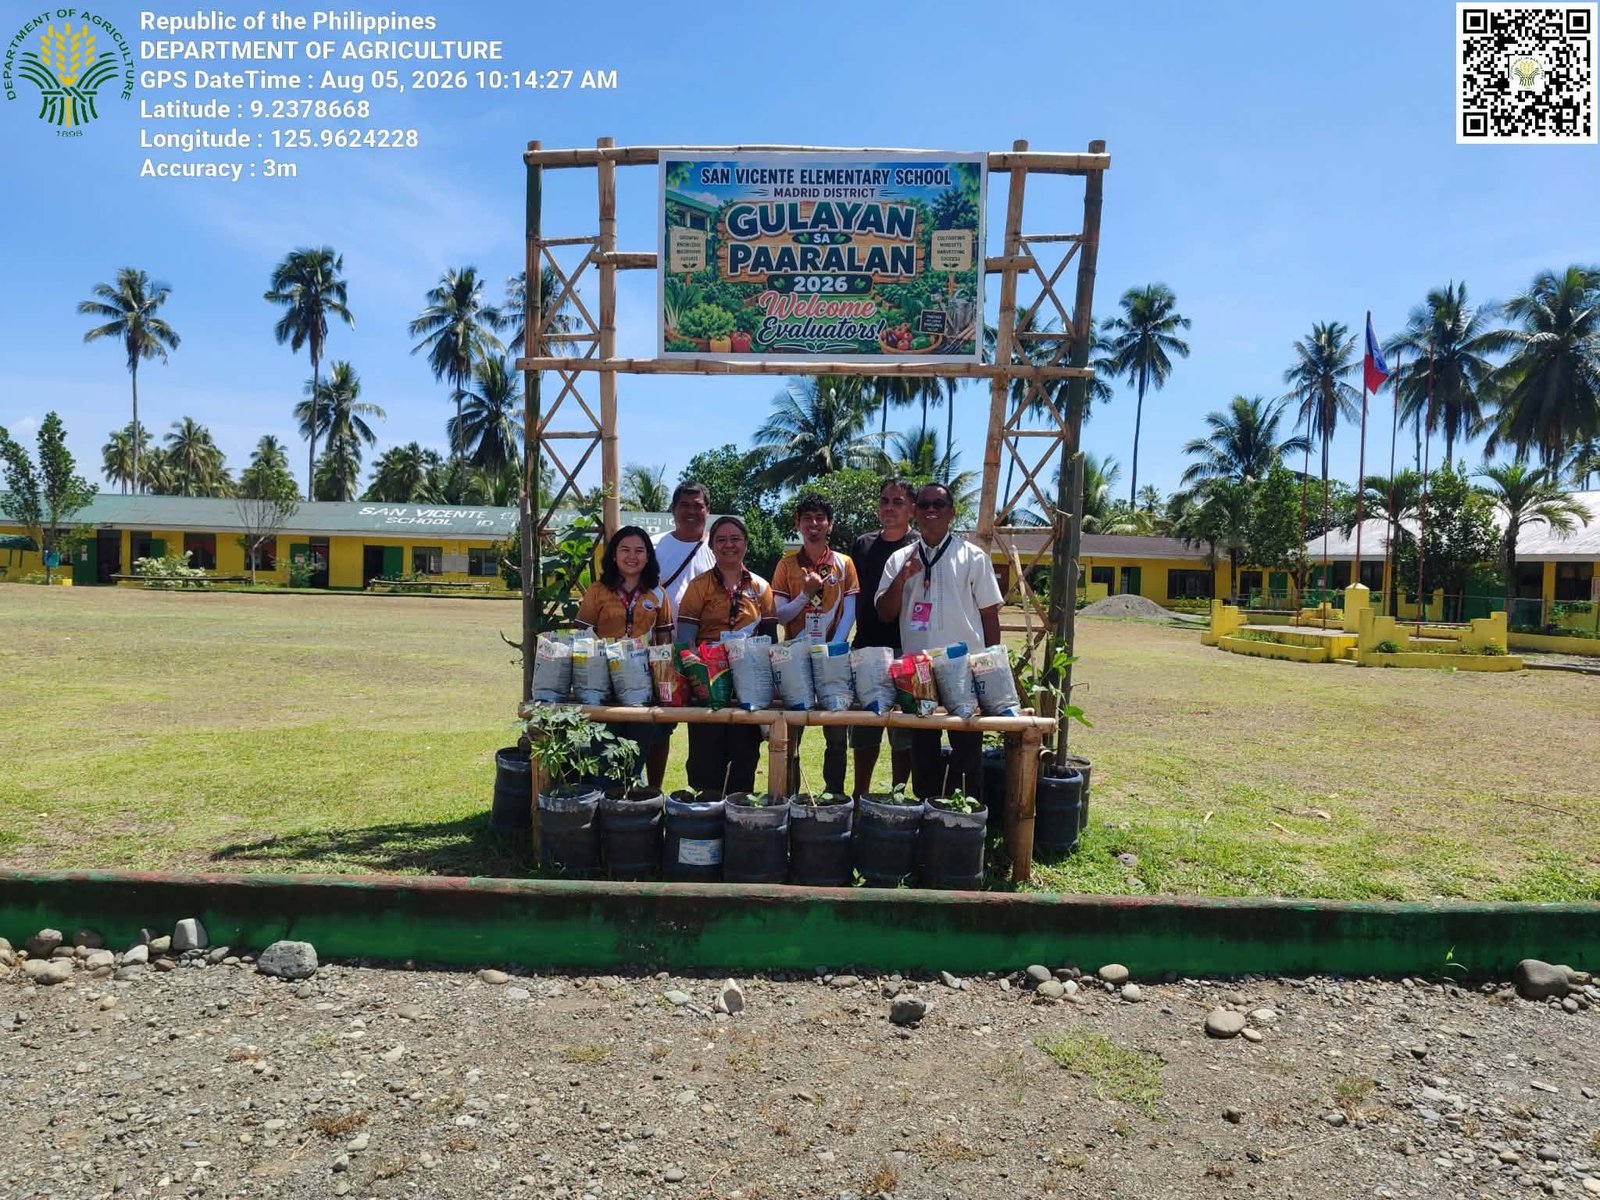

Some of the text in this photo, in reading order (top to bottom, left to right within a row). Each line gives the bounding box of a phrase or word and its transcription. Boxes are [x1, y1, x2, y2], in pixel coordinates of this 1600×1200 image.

[701, 168, 952, 186] SAN VICENTE ELEMENTARY SCHOOL
[774, 188, 876, 198] MADRID DISTRICT
[726, 201, 917, 240] GULAYAN
[813, 233, 831, 243] SA
[727, 242, 917, 277] PAARALAN
[793, 276, 848, 292] 2026
[759, 291, 878, 319] Welcome
[757, 316, 887, 345] Evaluators!
[359, 507, 488, 519] SAN VICENTE
[385, 517, 454, 526] SCHOOL
